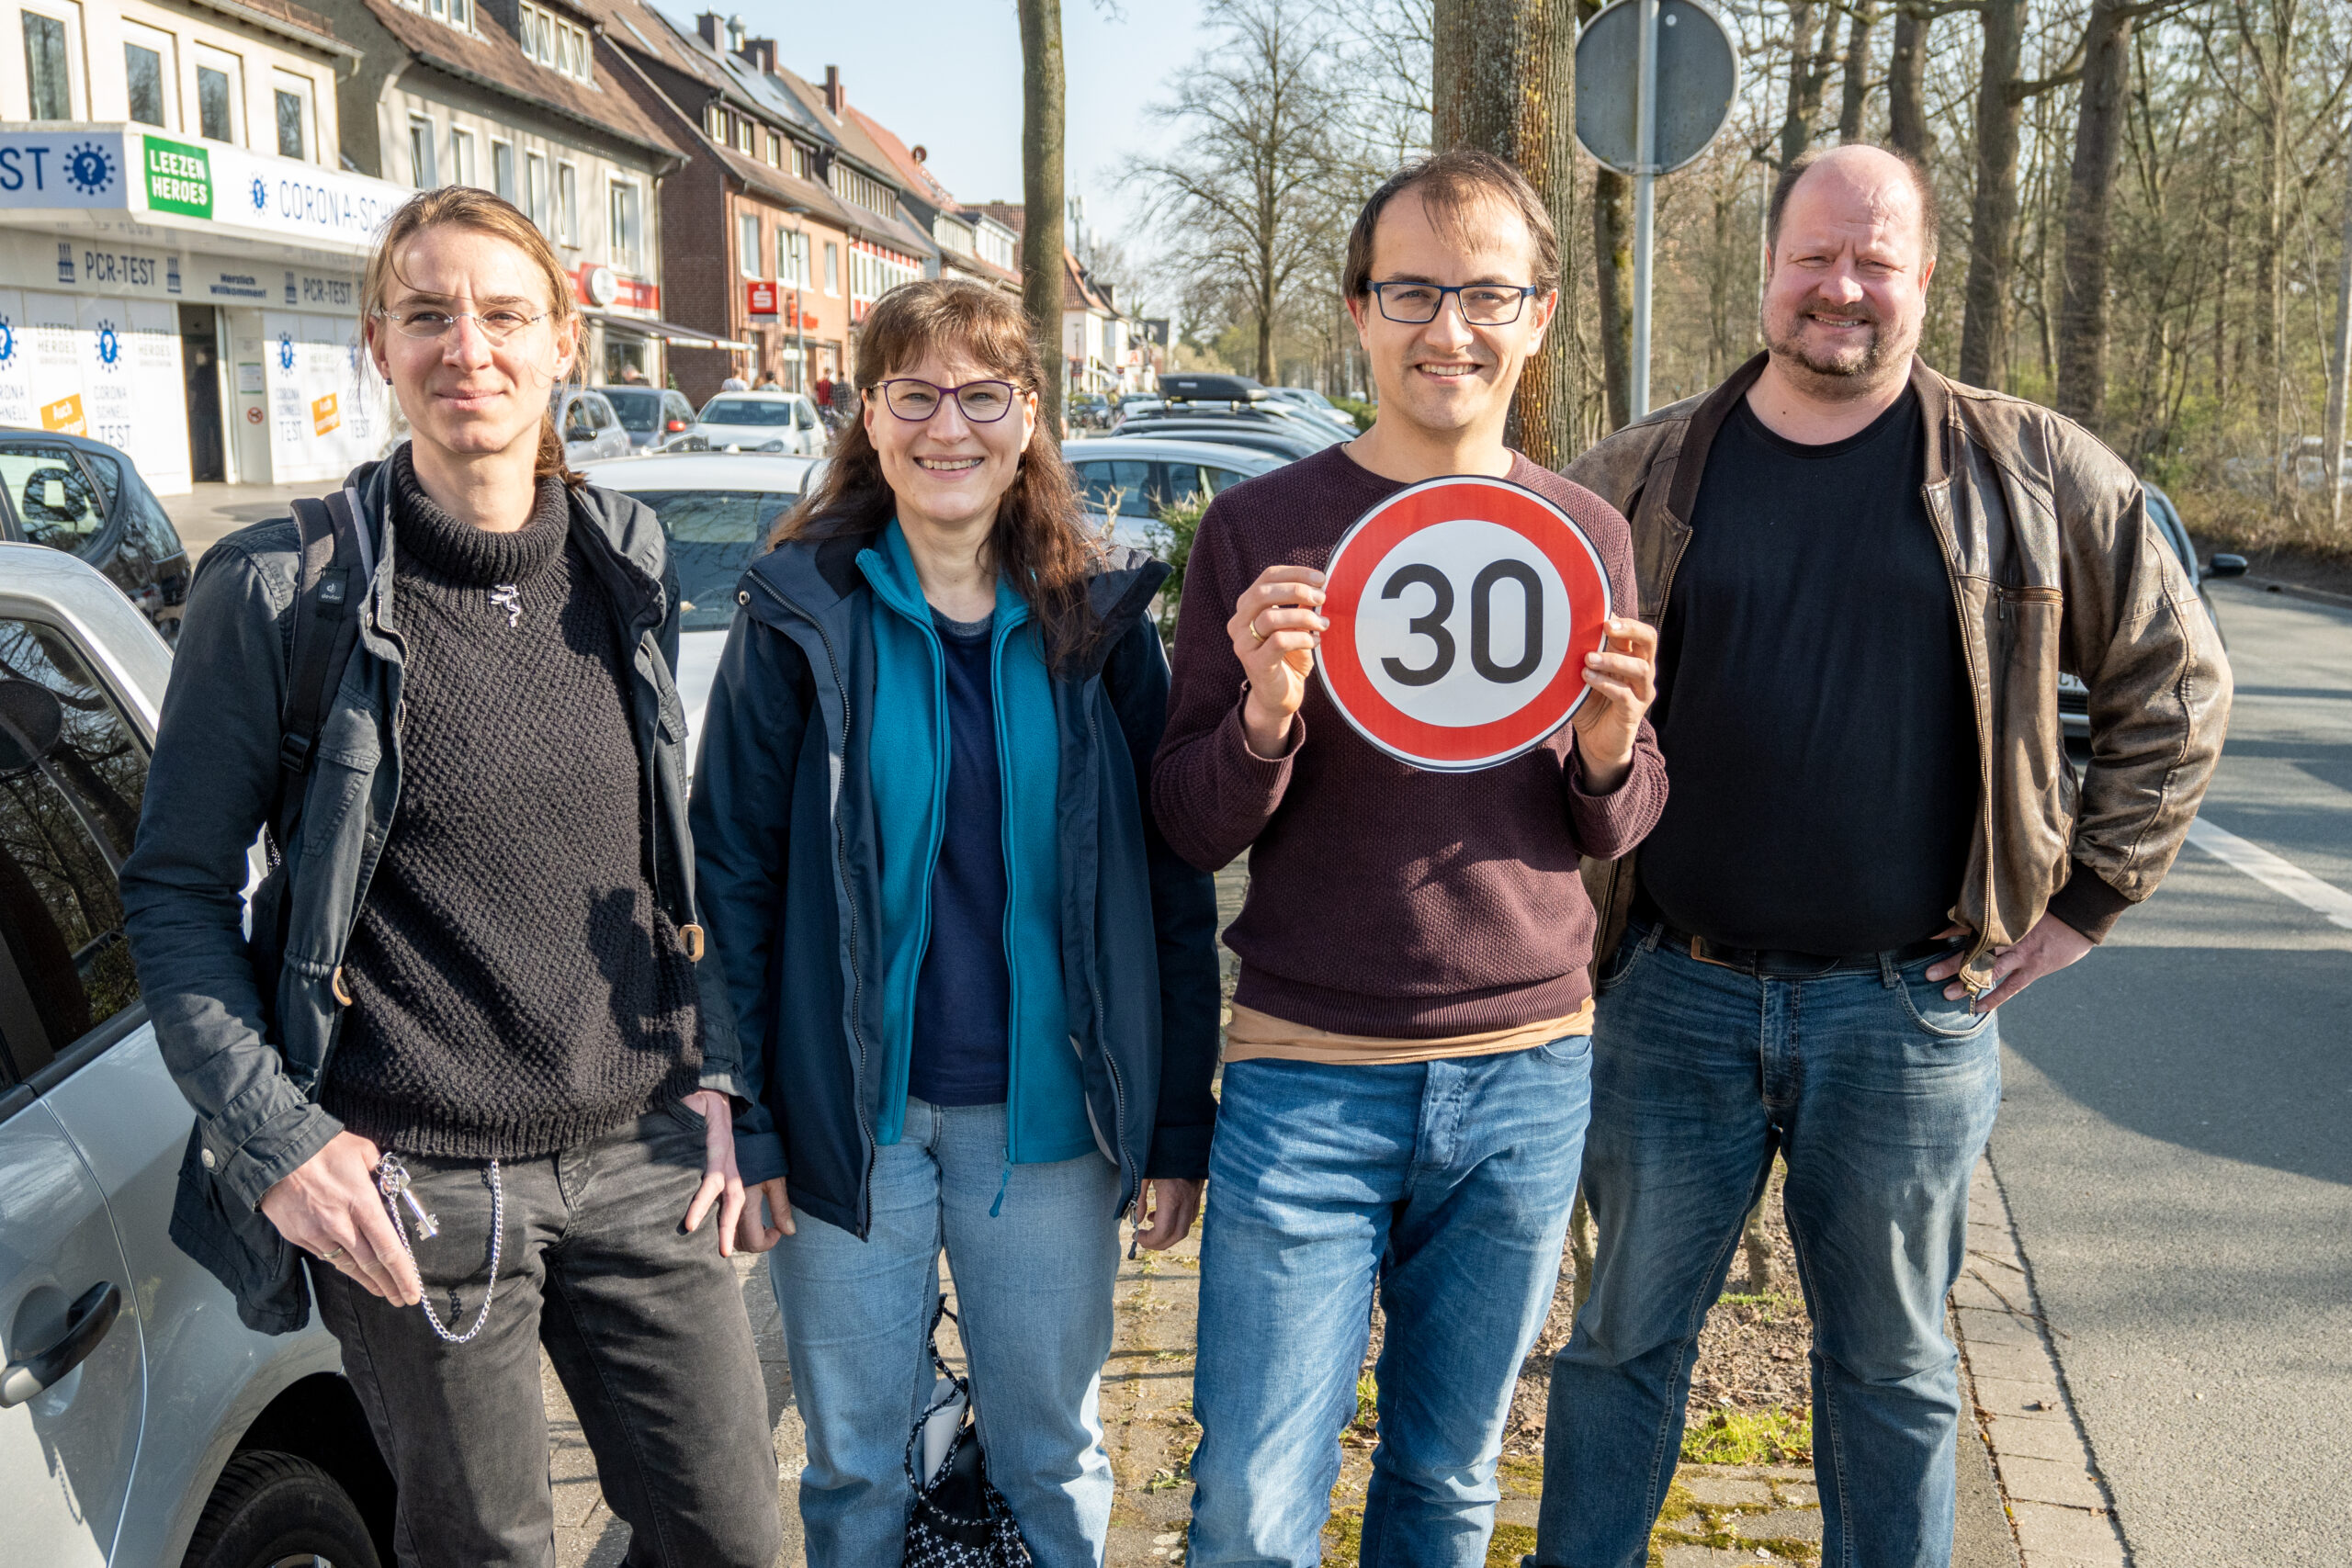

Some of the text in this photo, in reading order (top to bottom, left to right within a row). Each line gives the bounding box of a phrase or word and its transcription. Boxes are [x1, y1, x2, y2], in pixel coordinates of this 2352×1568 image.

[150, 149, 206, 181] LEEZEN
[152, 175, 208, 206] HEROES
[85, 251, 155, 287] PCR-TEST
[303, 277, 351, 305] PCR-TEST
[1381, 558, 1544, 687] 30
